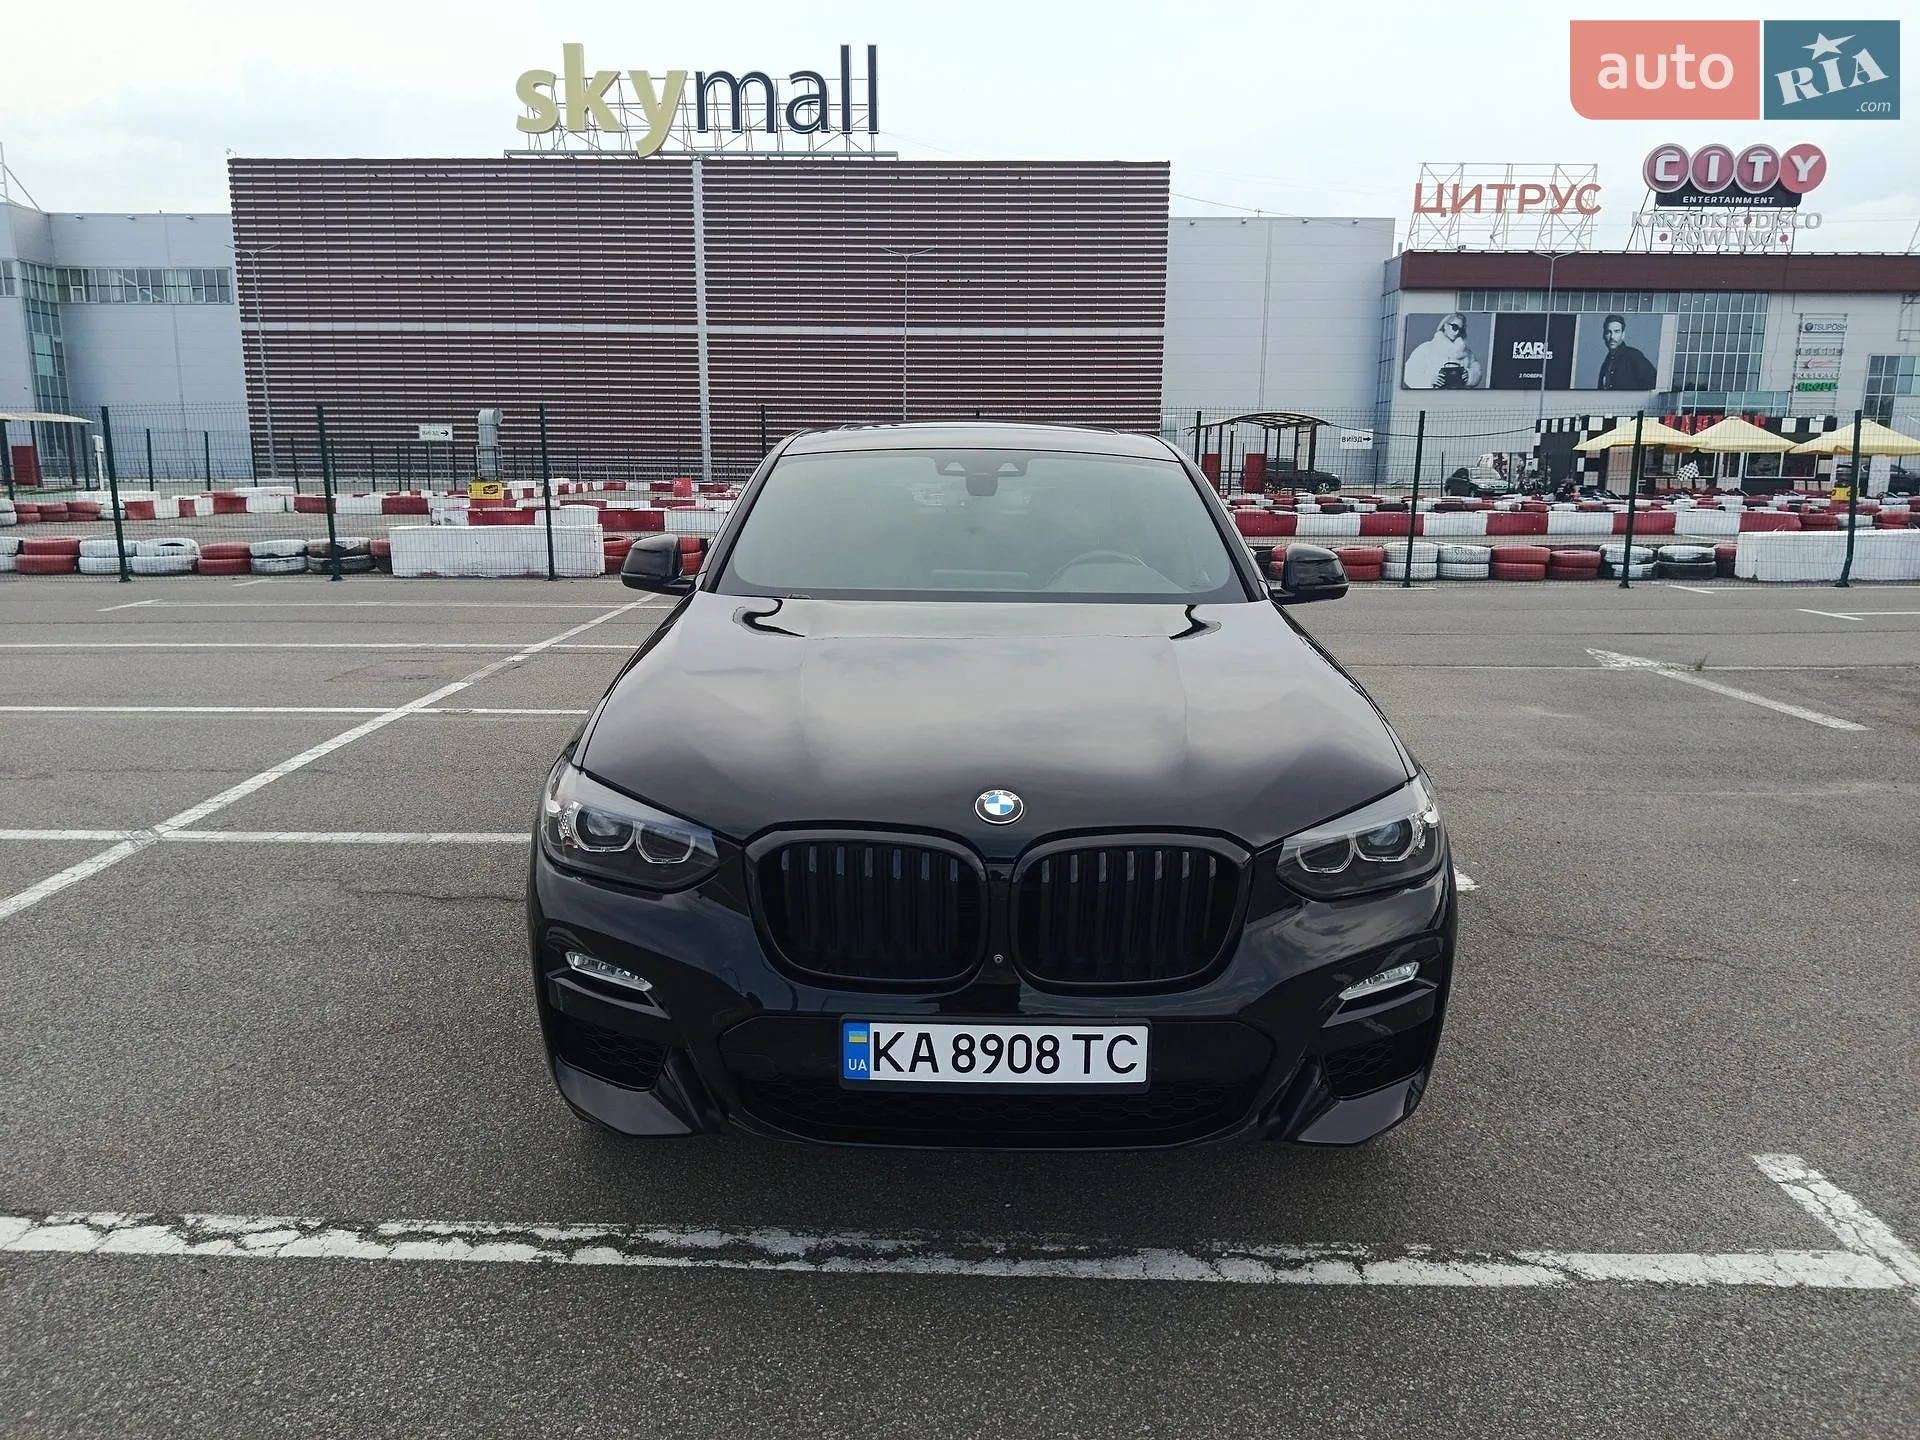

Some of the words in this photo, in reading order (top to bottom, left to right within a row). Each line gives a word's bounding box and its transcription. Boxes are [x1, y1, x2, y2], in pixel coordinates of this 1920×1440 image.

[515, 43, 880, 158] skymall
[1653, 153, 1822, 182] CITY
[1413, 181, 1602, 216] ЦИТРУС
[1682, 195, 1775, 205] ENTERTAINMENT
[1631, 211, 1740, 229] KARAOKE
[1755, 212, 1823, 229] DISCO
[1671, 229, 1777, 246] BOWLING
[1512, 341, 1553, 355] KARL
[873, 1031, 940, 1073] KA
[951, 1033, 1060, 1075] 8908
[1072, 1033, 1138, 1074] TC
[848, 1058, 867, 1071] UA
